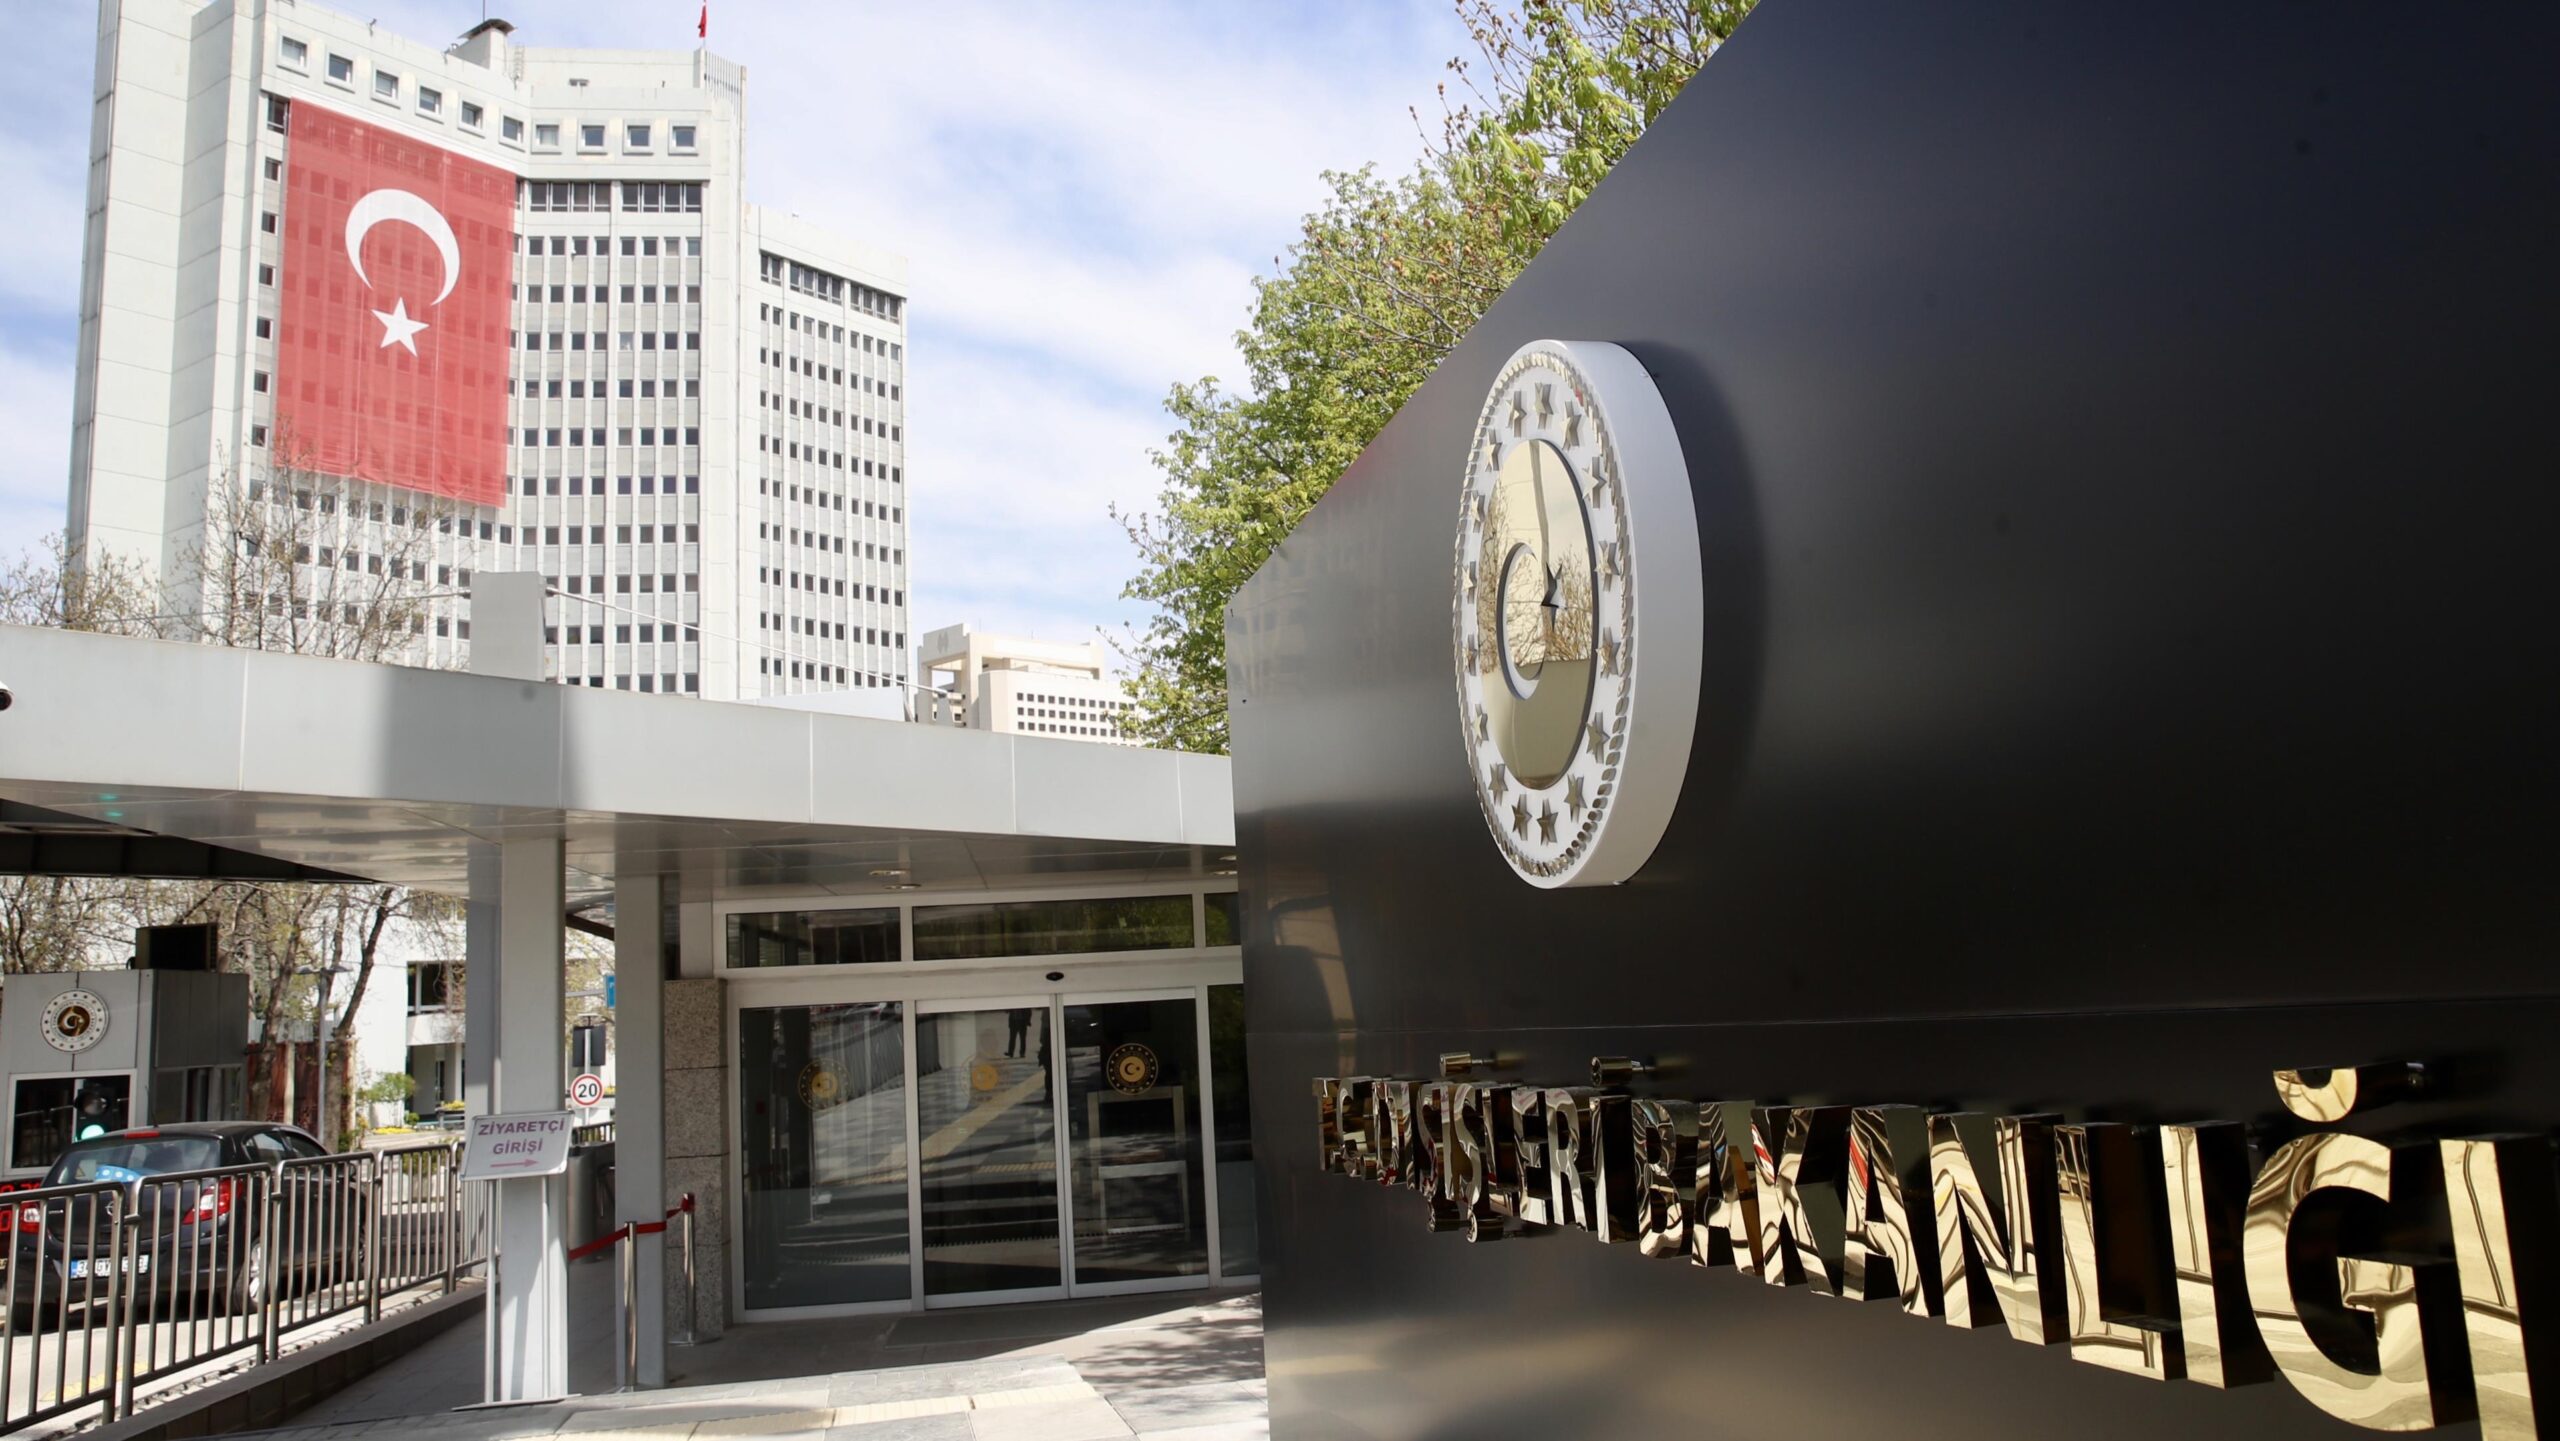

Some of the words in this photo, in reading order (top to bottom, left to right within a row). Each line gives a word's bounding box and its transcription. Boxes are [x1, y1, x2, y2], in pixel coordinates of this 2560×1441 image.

[577, 1083, 598, 1098] 20
[478, 1117, 566, 1136] ZİYARETÇİ
[492, 1138, 544, 1155] GİRİŞİ
[1632, 1068, 2540, 1441] BAKANLIĞI
